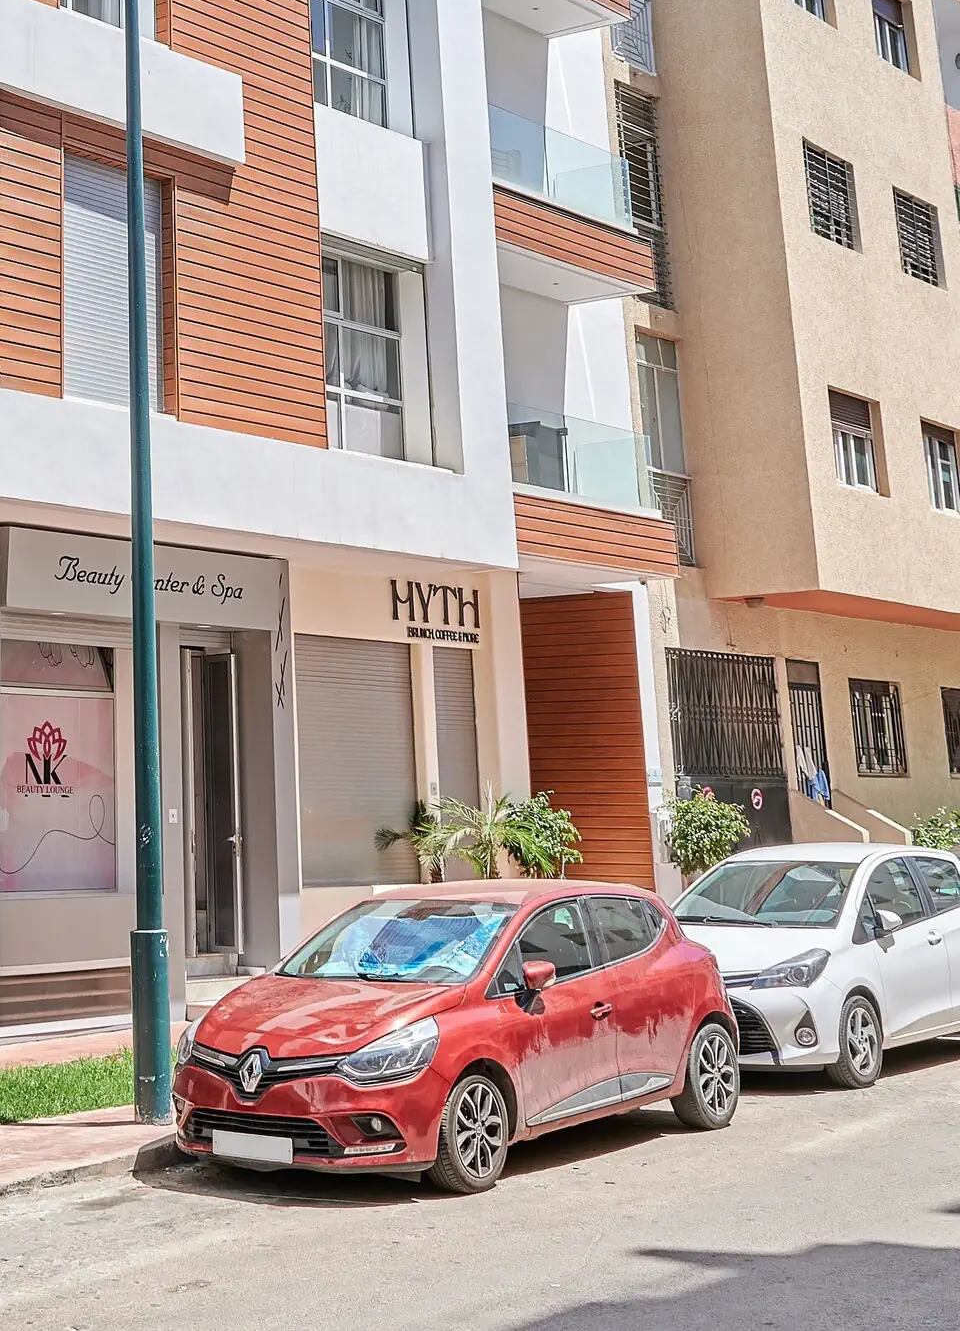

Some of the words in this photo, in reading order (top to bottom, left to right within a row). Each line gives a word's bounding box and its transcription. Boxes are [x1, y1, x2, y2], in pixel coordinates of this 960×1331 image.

[54, 556, 125, 595] Beauty
[192, 575, 205, 595] &
[211, 573, 244, 605] Spa
[390, 579, 480, 629] MYTH
[435, 629, 458, 642] COFFEE
[463, 632, 480, 644] MORE
[25, 753, 68, 785] NK
[16, 785, 45, 794] BEAUTY
[46, 785, 74, 794] LOUNGE
